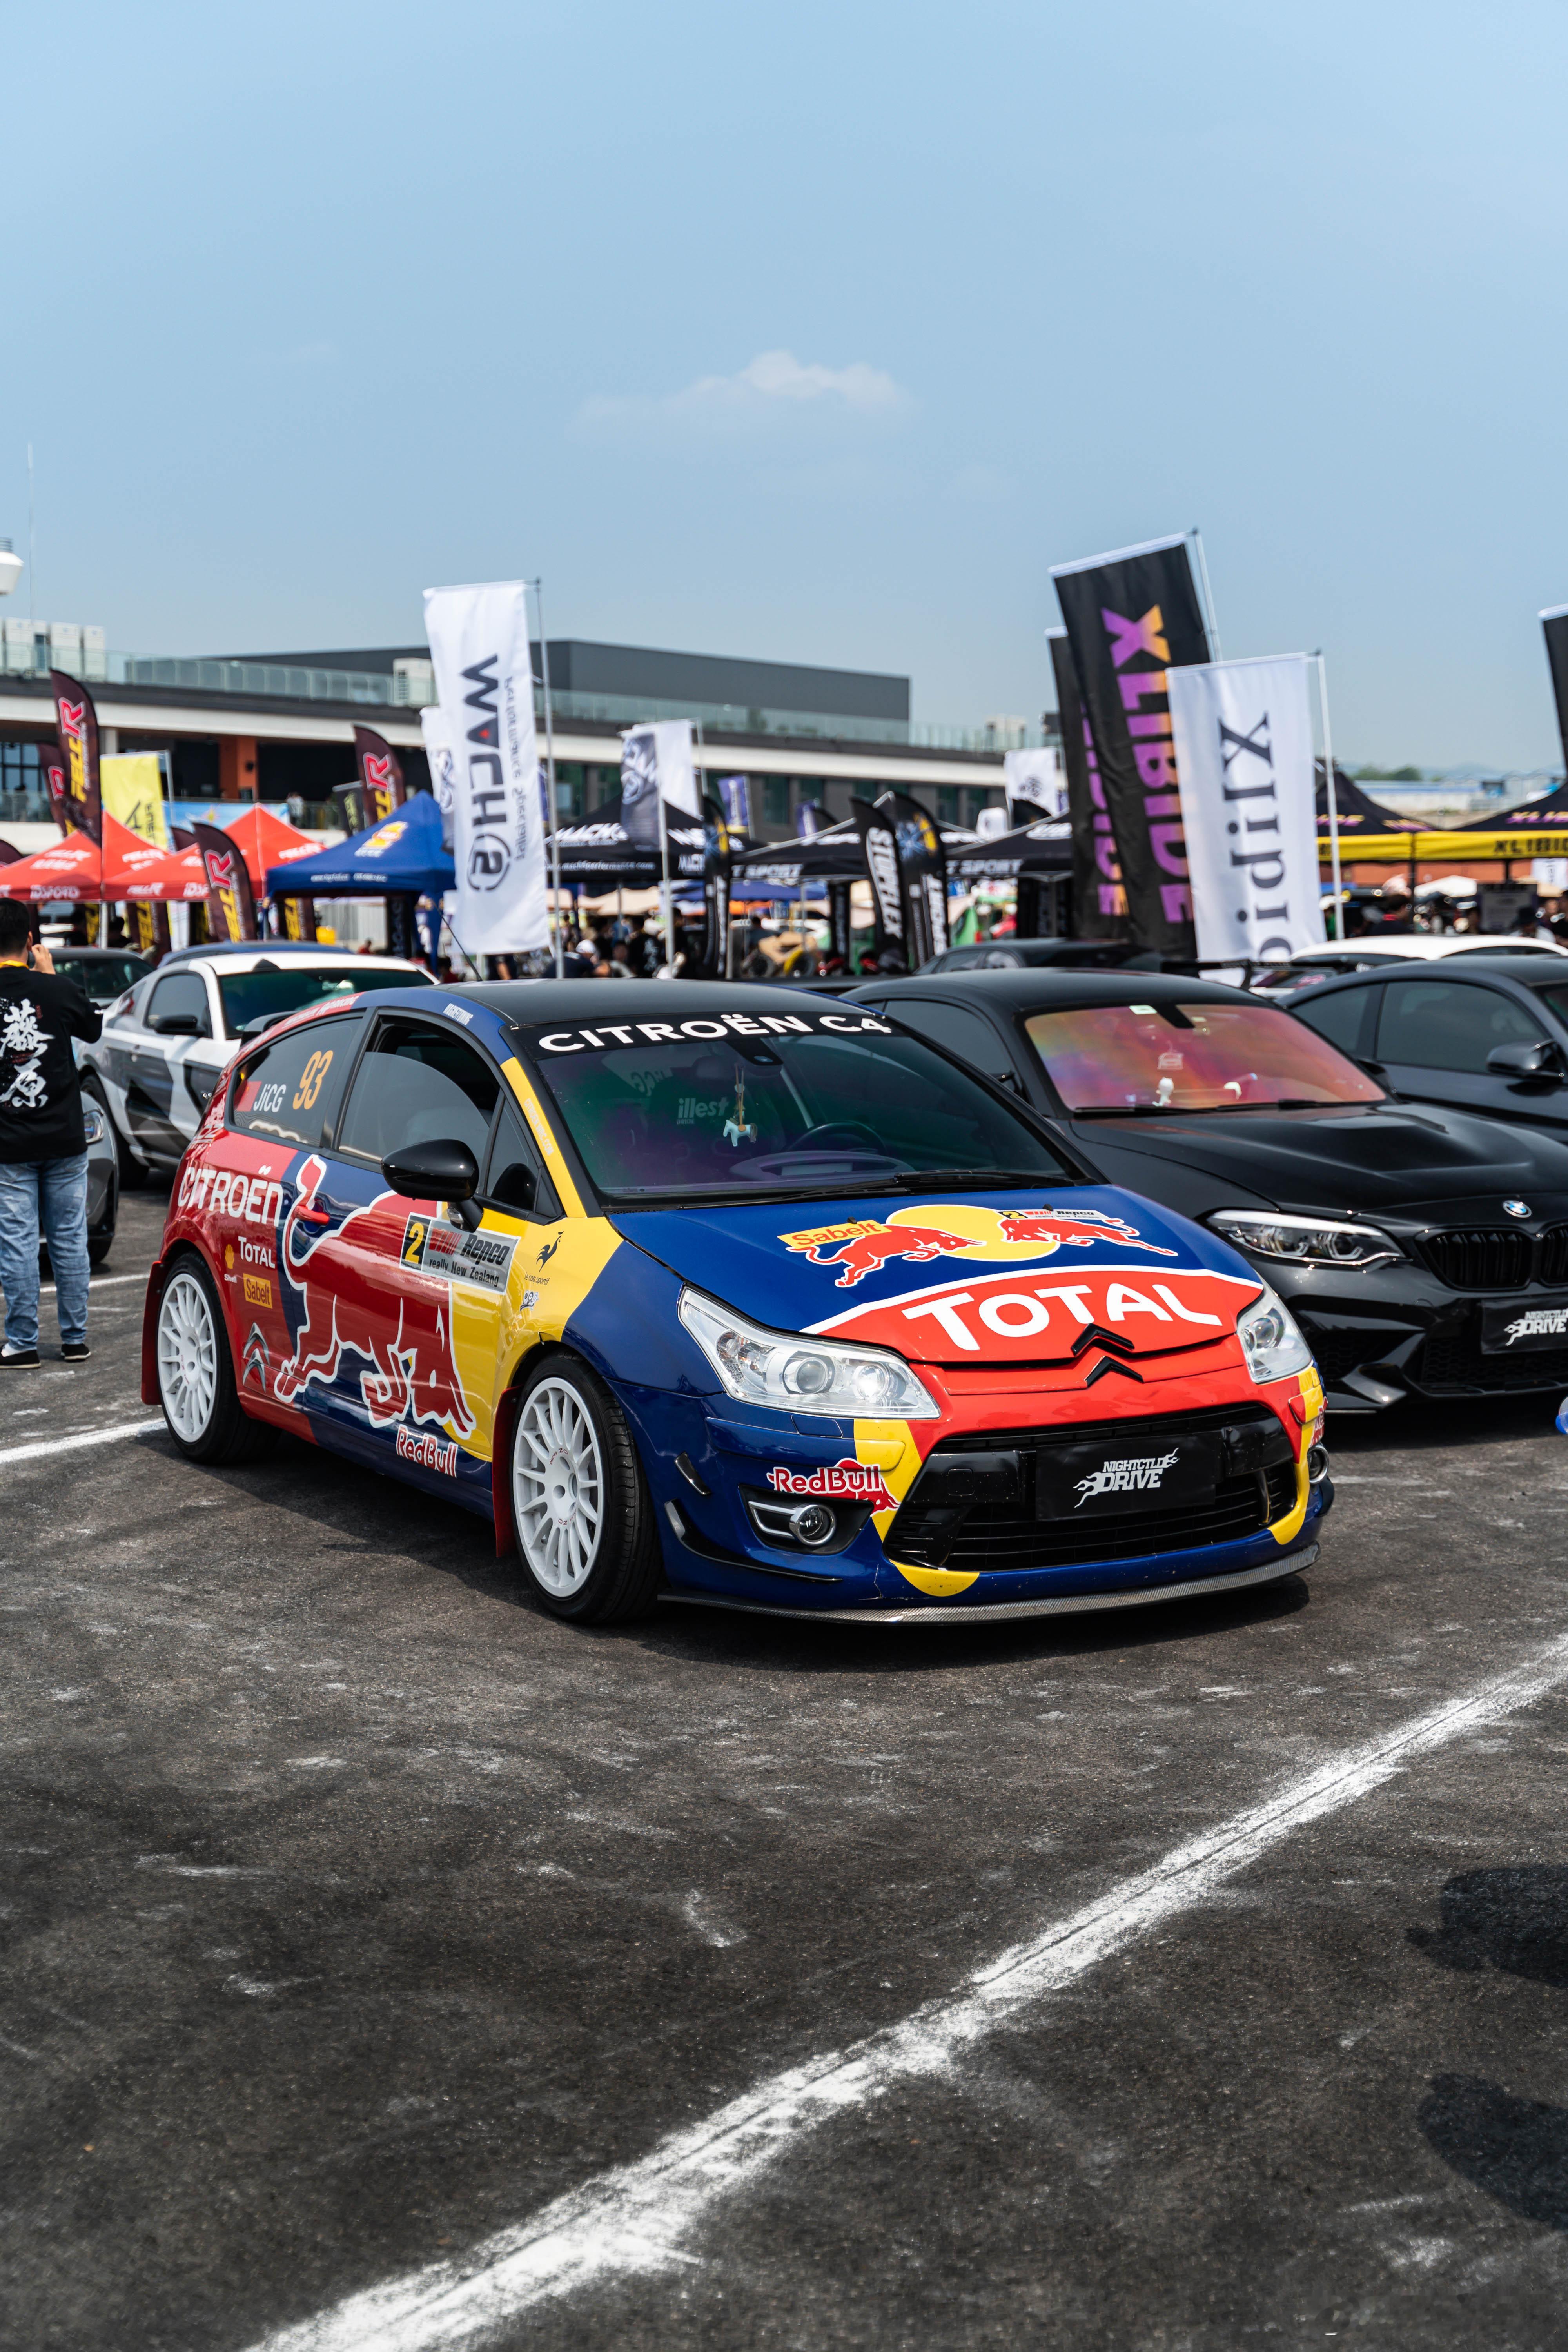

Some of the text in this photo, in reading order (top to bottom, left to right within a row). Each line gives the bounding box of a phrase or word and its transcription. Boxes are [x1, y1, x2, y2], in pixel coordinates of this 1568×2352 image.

[1101, 604, 1194, 923] XLIBIDE
[539, 1014, 892, 1051] CITROËN C4
[293, 1050, 333, 1110] 93
[677, 1097, 729, 1118] illest
[177, 1165, 283, 1227] CITROËN
[405, 1223, 424, 1264] 2
[791, 1223, 881, 1245] Sabelt
[460, 1234, 510, 1265] Repco
[224, 1274, 237, 1283] Shell
[429, 1258, 449, 1273] really
[451, 1262, 467, 1277] New
[524, 1272, 528, 1280] le
[535, 1277, 550, 1285] sportif
[246, 1278, 270, 1306] Sabelt
[901, 1283, 1223, 1351] TOTAL
[1519, 1318, 1567, 1335] DRIVE
[1097, 1468, 1163, 1492] DRIVE
